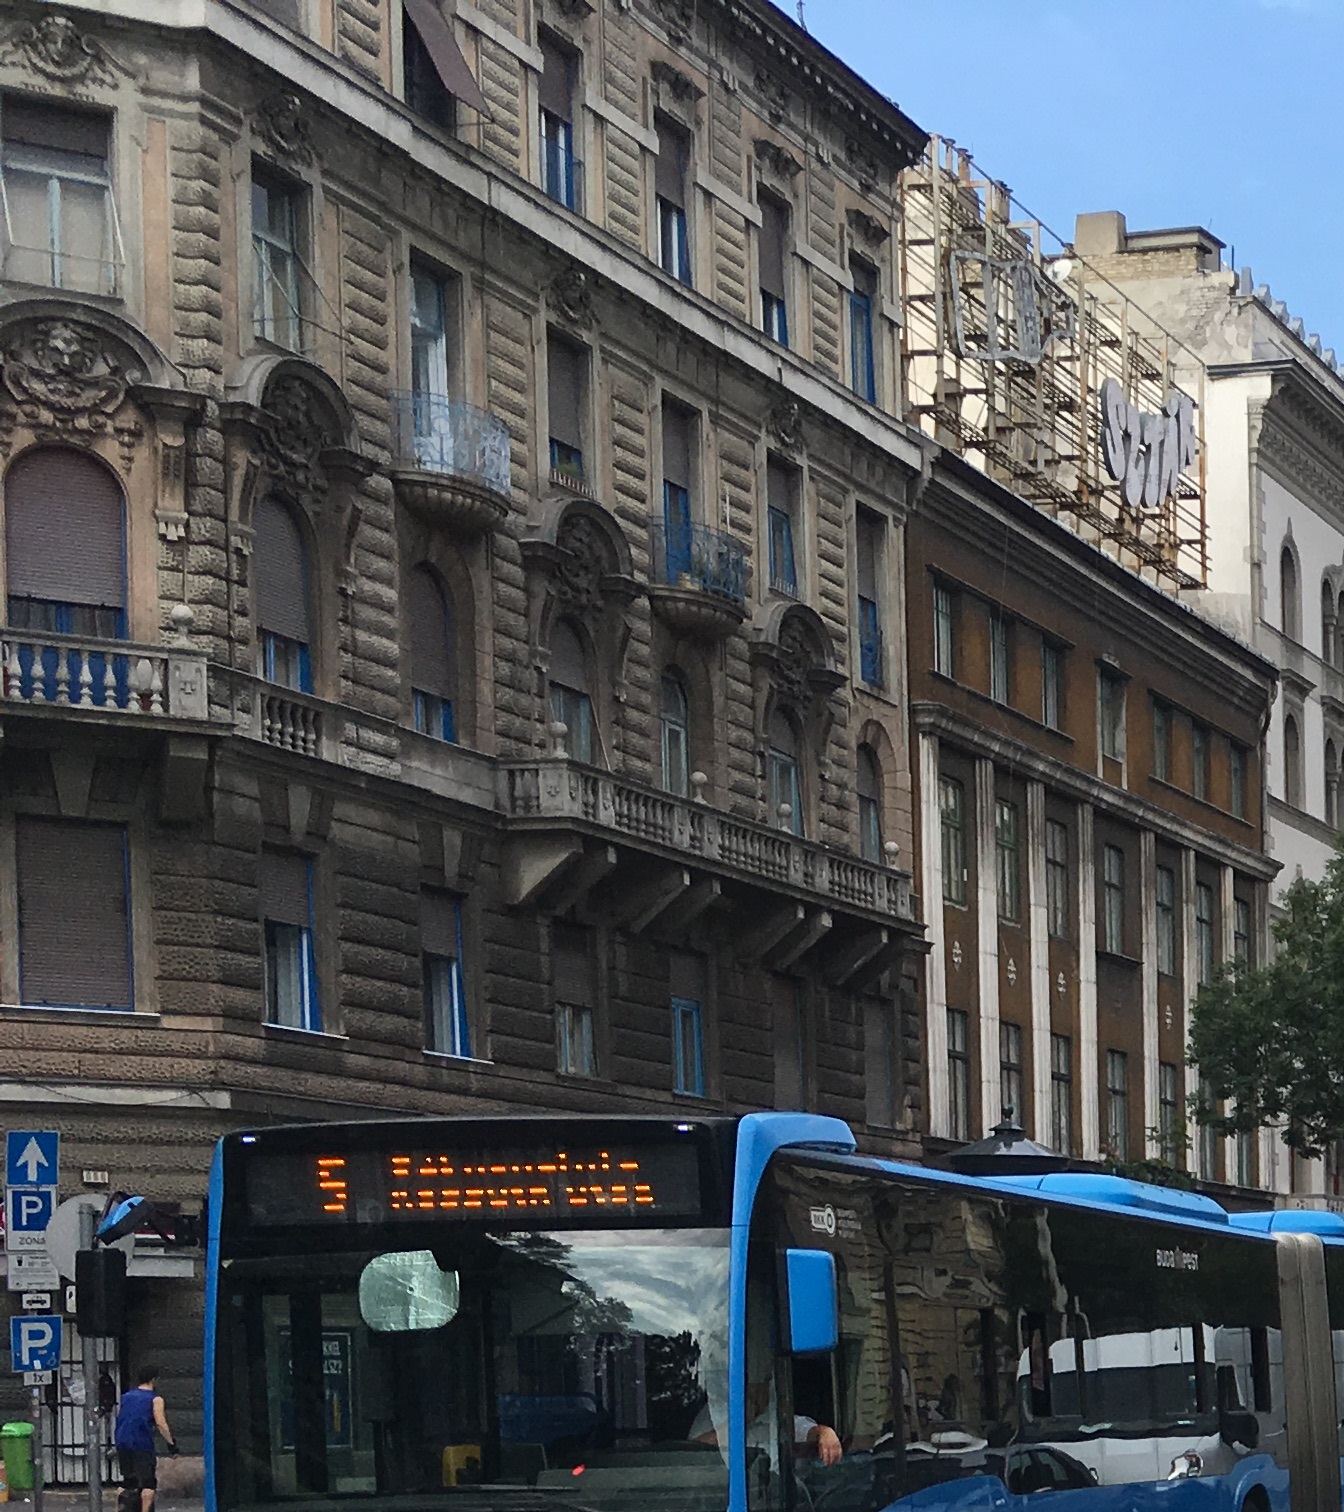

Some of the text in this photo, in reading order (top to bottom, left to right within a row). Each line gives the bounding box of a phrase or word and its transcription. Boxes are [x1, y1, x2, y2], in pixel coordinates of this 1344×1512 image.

[318, 1158, 346, 1210] 5
[21, 1196, 43, 1226] P
[20, 1321, 53, 1365] P
